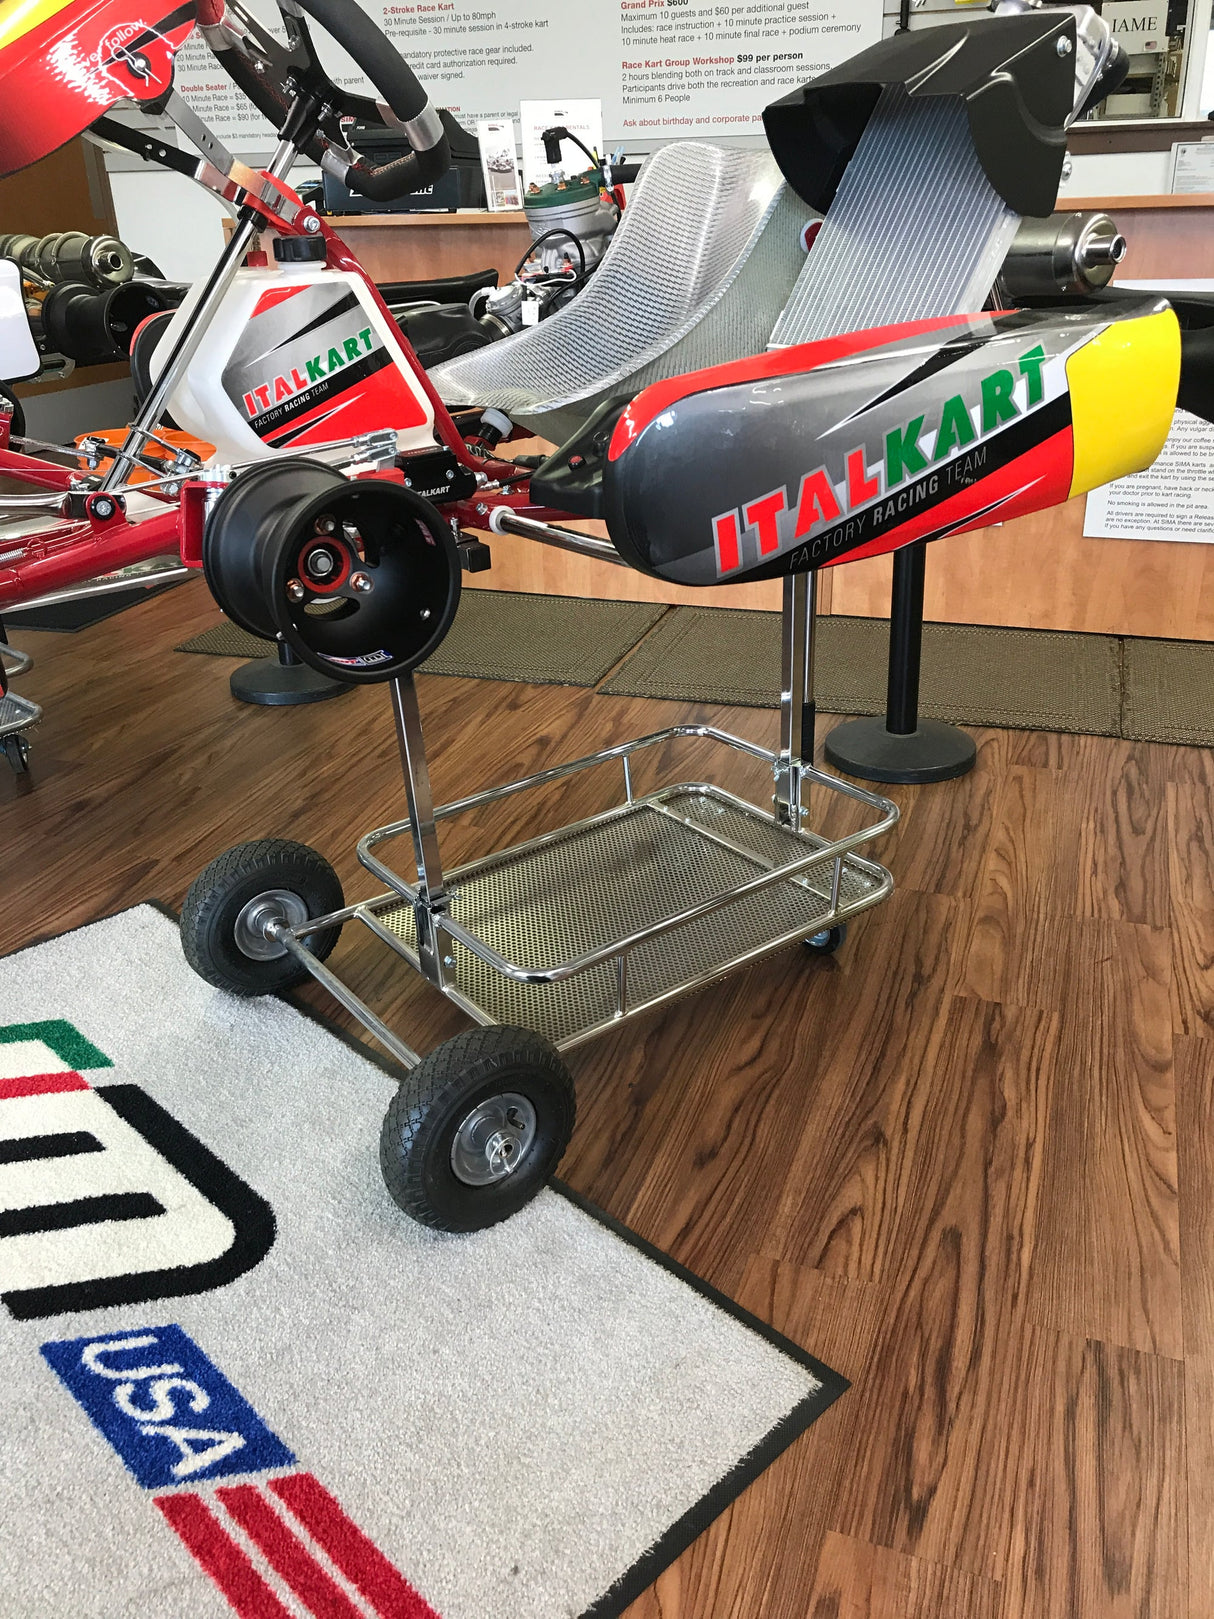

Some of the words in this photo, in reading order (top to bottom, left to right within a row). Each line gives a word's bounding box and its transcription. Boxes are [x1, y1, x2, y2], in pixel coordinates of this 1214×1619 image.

[383, 6, 414, 15] 2-Stroke
[417, 5, 436, 13] Race
[438, 3, 454, 11] Kart
[621, 1, 646, 10] Grand
[648, 0, 664, 8] Prix
[621, 13, 657, 22] Maximum
[660, 11, 669, 19] 10
[671, 9, 696, 20] guests
[698, 8, 712, 16] and
[715, 6, 730, 16] $60
[732, 7, 744, 16] per
[746, 4, 784, 14] additional
[787, 1, 810, 13] guest
[384, 18, 392, 26] 30
[394, 16, 416, 26] Minute
[418, 14, 445, 24] Session
[451, 13, 461, 22] Up
[463, 13, 470, 21] to
[472, 11, 496, 21] 80mph
[621, 25, 654, 34] Includes:
[656, 24, 672, 32] race
[674, 21, 714, 30] instruction
[725, 19, 734, 27] 10
[736, 17, 762, 26] minute
[764, 14, 796, 26] practice
[799, 13, 828, 22] session
[1112, 16, 1158, 33] IAME
[105, 18, 147, 50] follow.
[385, 27, 427, 38] Pre-requisite
[434, 26, 442, 34] 30
[444, 25, 466, 34] minute
[468, 24, 494, 32] session
[496, 22, 502, 31] in
[504, 20, 533, 30] 4-stroke
[535, 19, 548, 28] kart
[622, 38, 630, 46] 10
[632, 36, 658, 46] minute
[660, 34, 676, 44] heat
[678, 34, 694, 42] race
[704, 32, 714, 40] 10
[716, 31, 742, 40] minute
[744, 29, 760, 38] final
[762, 28, 779, 37] race
[789, 26, 819, 37] podium
[822, 24, 862, 34] ceremony
[186, 53, 206, 61] Minute
[434, 48, 467, 58] protective
[468, 47, 484, 55] race
[486, 46, 500, 56] gear
[502, 44, 534, 53] included.
[178, 64, 186, 72] 30
[426, 60, 441, 69] card
[442, 58, 486, 68] authorization
[488, 56, 518, 66] required.
[622, 60, 642, 70] Race
[644, 60, 662, 68] Kart
[665, 58, 690, 68] Group
[693, 56, 734, 66] Workshop
[737, 54, 754, 63] $99
[756, 54, 770, 63] per
[772, 52, 804, 62] person
[344, 77, 364, 85] parent
[440, 71, 464, 81] signed.
[622, 72, 627, 81] 2
[629, 72, 650, 80] hours
[652, 70, 683, 80] blending
[685, 69, 702, 78] both
[716, 67, 736, 76] track
[737, 66, 752, 75] and
[754, 64, 794, 74] classroom
[181, 84, 204, 92] Double
[206, 83, 227, 91] Seater
[622, 82, 666, 93] Participants
[668, 80, 686, 90] drive
[688, 80, 704, 89] both
[707, 79, 718, 88] the
[721, 78, 758, 88] recreation
[760, 76, 776, 85] and
[778, 76, 794, 85] race
[622, 96, 656, 104] Minimum
[658, 94, 662, 102] 6
[665, 94, 690, 102] People
[215, 114, 230, 122] Race
[623, 118, 637, 127] Ask
[639, 118, 660, 126] about
[662, 116, 693, 126] birthday
[696, 116, 710, 124] and
[712, 114, 750, 124] corporate
[243, 327, 373, 419] ITALKART
[254, 408, 283, 429] FACTORY
[284, 392, 311, 412] RACING
[312, 382, 329, 398] TEAM
[711, 339, 1047, 580] ITALKART
[789, 515, 865, 569] FACTORY
[872, 475, 939, 527] RACING
[946, 446, 987, 486] TEAM
[81, 1333, 247, 1480] USA
